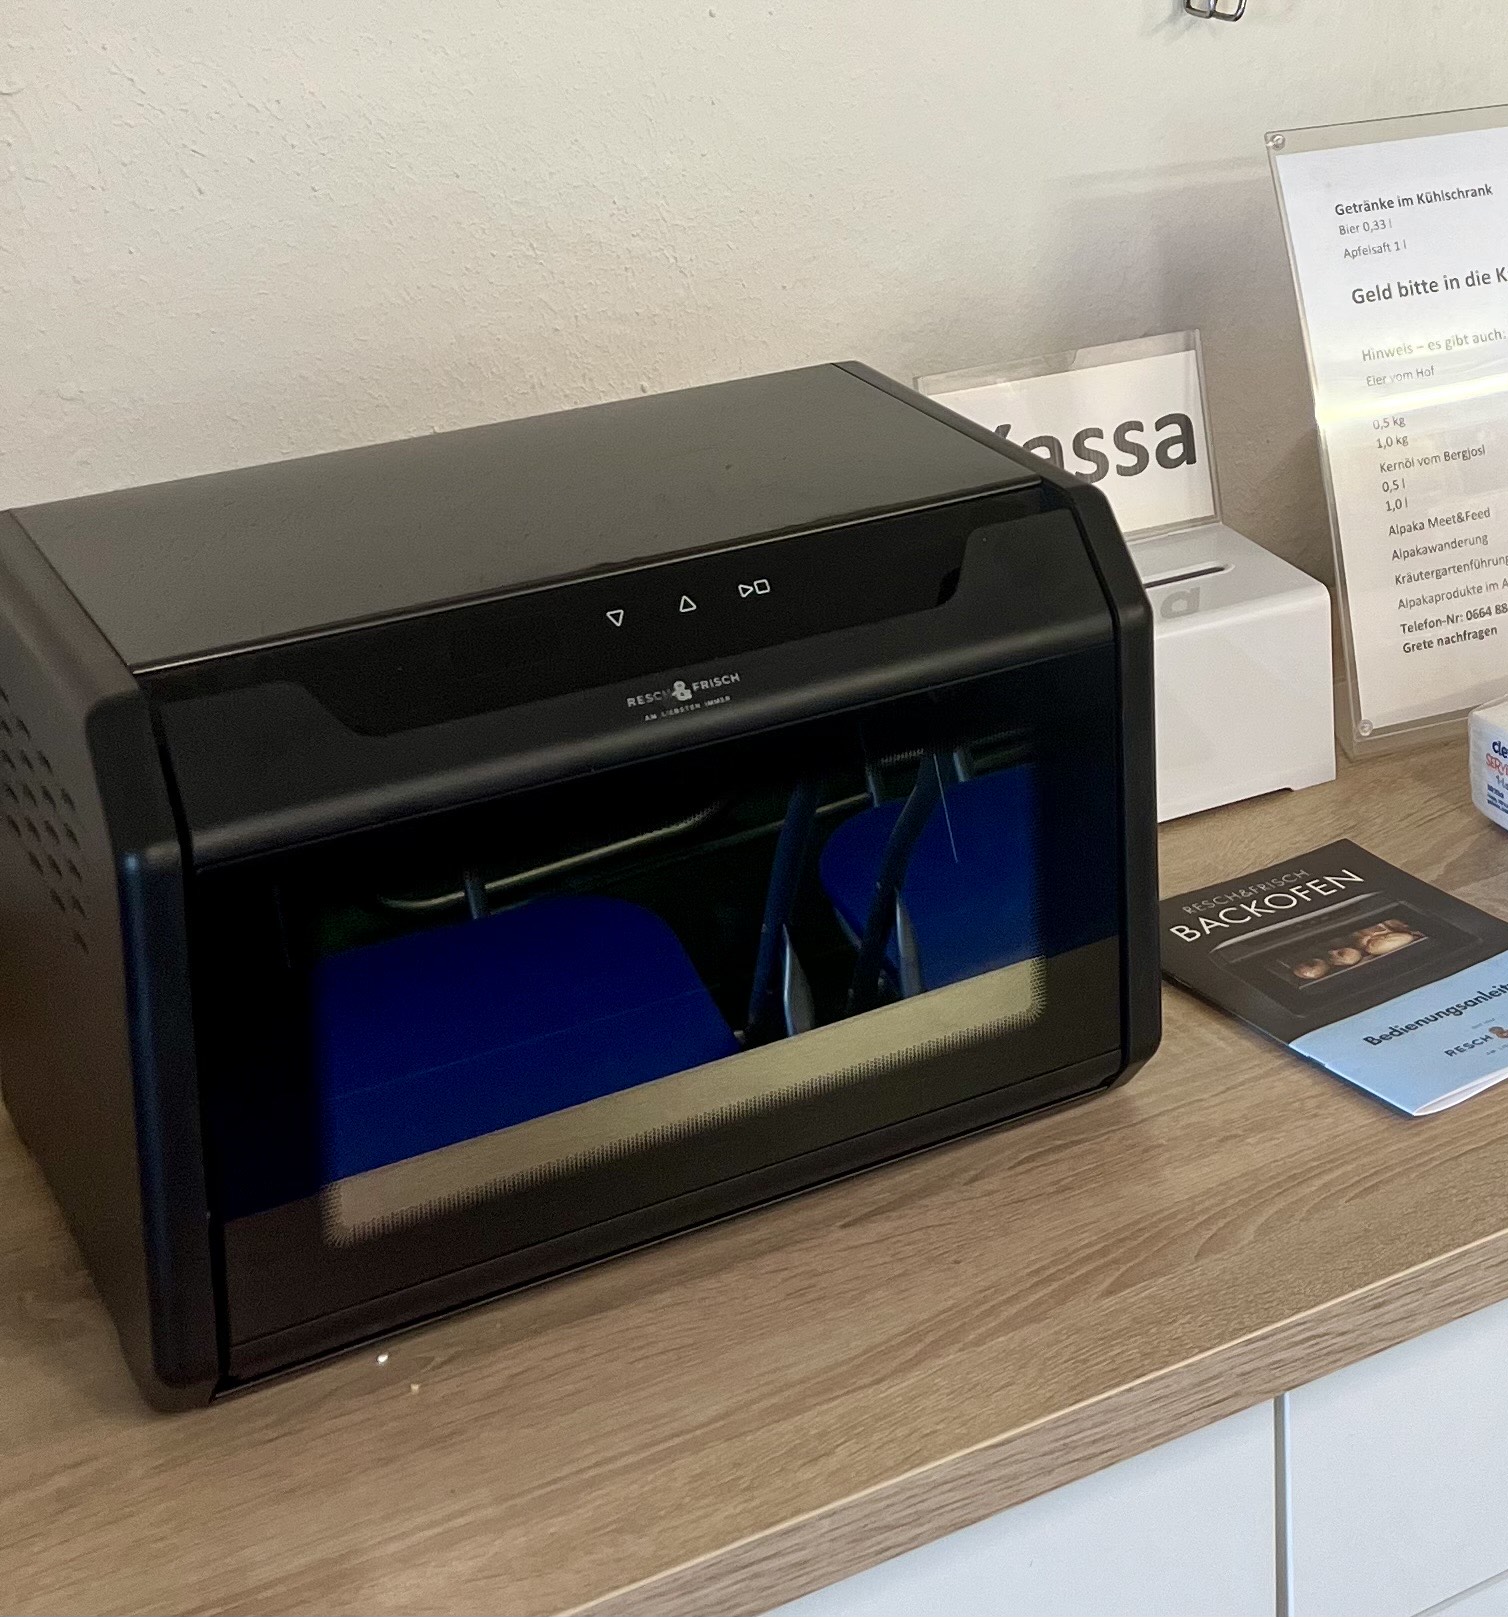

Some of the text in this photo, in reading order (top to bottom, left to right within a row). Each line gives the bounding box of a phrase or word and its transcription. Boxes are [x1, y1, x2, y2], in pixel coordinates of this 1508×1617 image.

[1334, 183, 1493, 216] Getränke im Kühlschrank
[1337, 224, 1360, 236] Bier
[1362, 218, 1387, 233] 0,33
[1343, 241, 1392, 260] Apfelsaft
[1393, 240, 1401, 252] 1
[1351, 282, 1393, 304] Geld
[1396, 279, 1440, 298] bitte
[1442, 274, 1461, 291] in
[1464, 269, 1491, 287] die
[1361, 327, 1507, 362] Hinweis es gibt auch:
[995, 413, 1197, 484] assa
[1376, 435, 1409, 450] 1,0 kg
[1379, 456, 1415, 473] Kernöl
[1416, 454, 1441, 467] vom
[1388, 506, 1491, 537] Alpaka Meet&Feed
[1391, 533, 1489, 561] Alpakawanderung
[1397, 584, 1483, 610] Alpakaprodukte
[1485, 581, 1499, 592] im
[1399, 613, 1463, 635] Telefon-Nr:
[1465, 605, 1492, 621] 0664
[1402, 626, 1498, 654] Grete nachfragen
[691, 672, 741, 692] FRISCH
[1169, 869, 1365, 943] BACKOFEN
[1182, 869, 1310, 915] RESCH&FRISCH
[1444, 1034, 1494, 1057] RESCH
